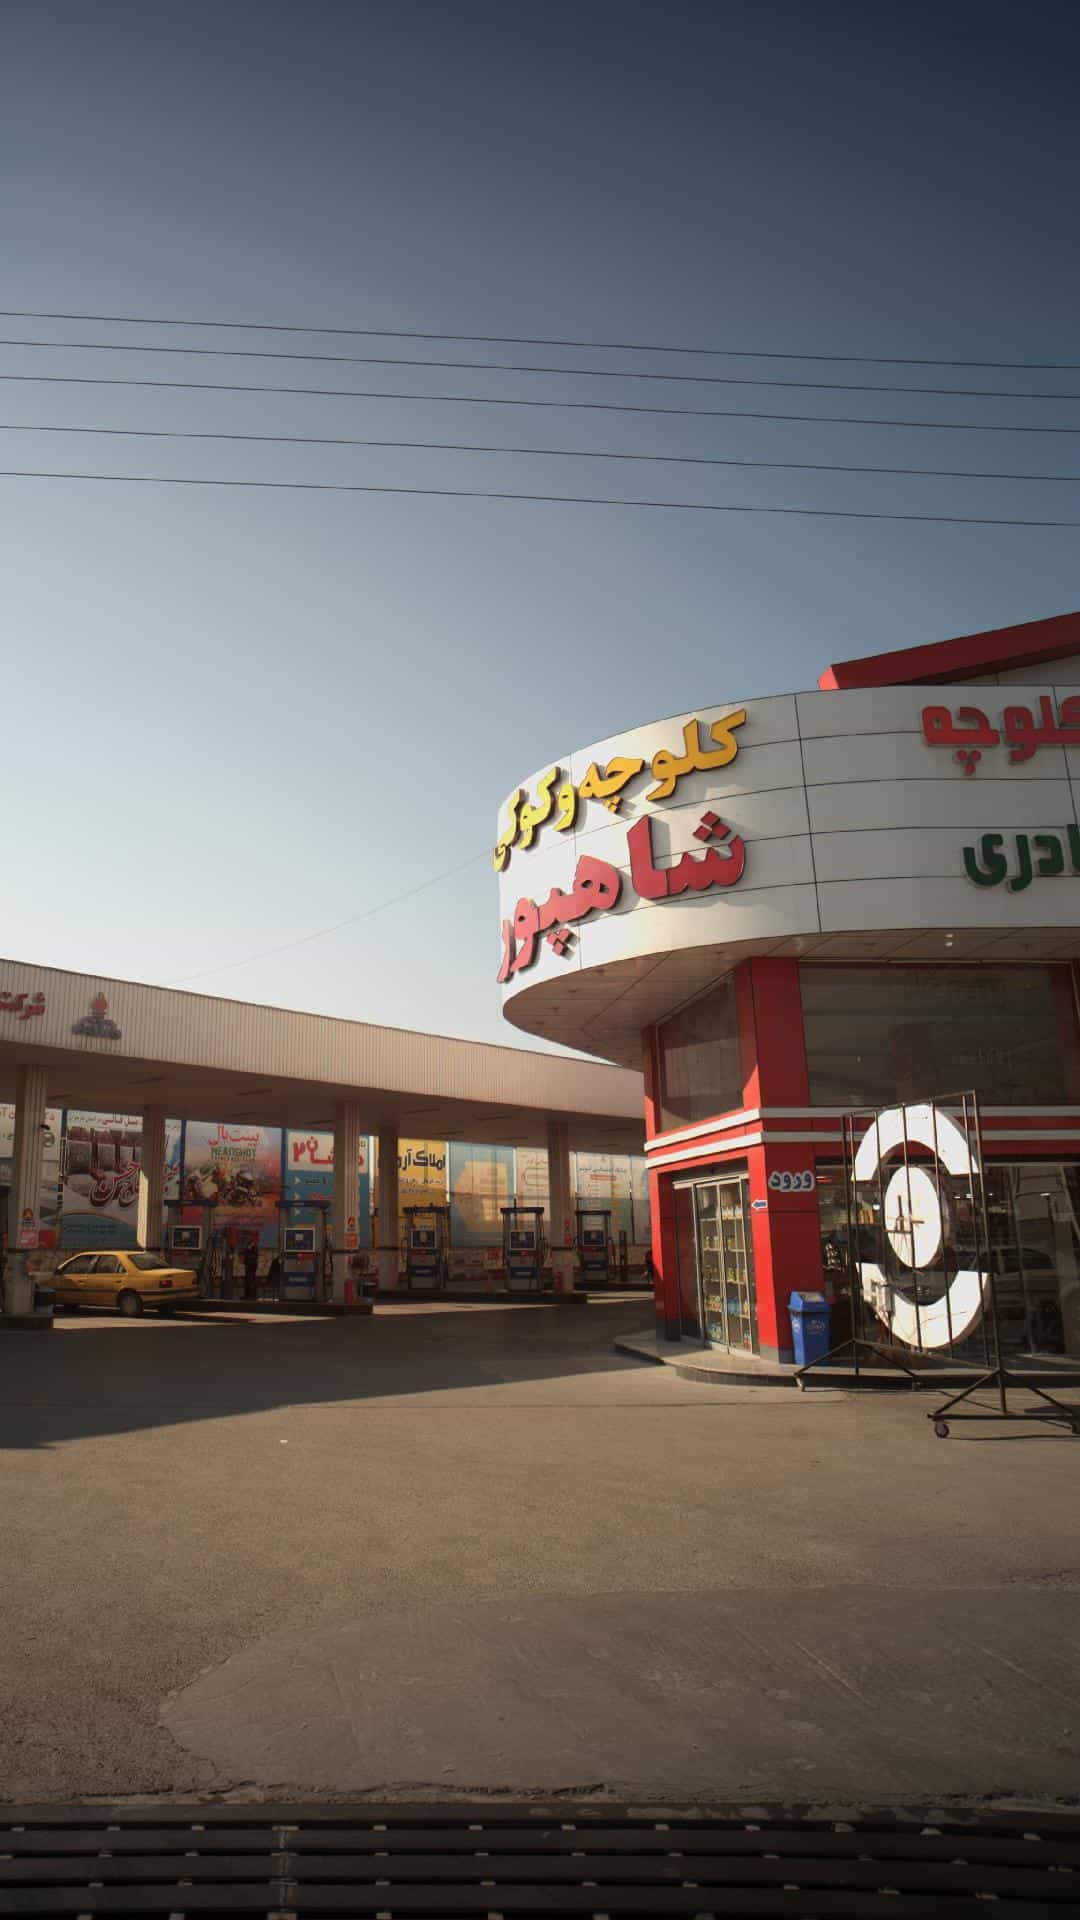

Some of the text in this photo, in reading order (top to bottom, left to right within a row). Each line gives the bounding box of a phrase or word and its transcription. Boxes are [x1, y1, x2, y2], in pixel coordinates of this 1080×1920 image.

[578, 708, 746, 813] کلوچه
[962, 824, 1080, 892] ادری
[497, 810, 746, 983] شاهپور
[413, 1149, 447, 1170] املاک
[769, 1171, 814, 1191] ورود
